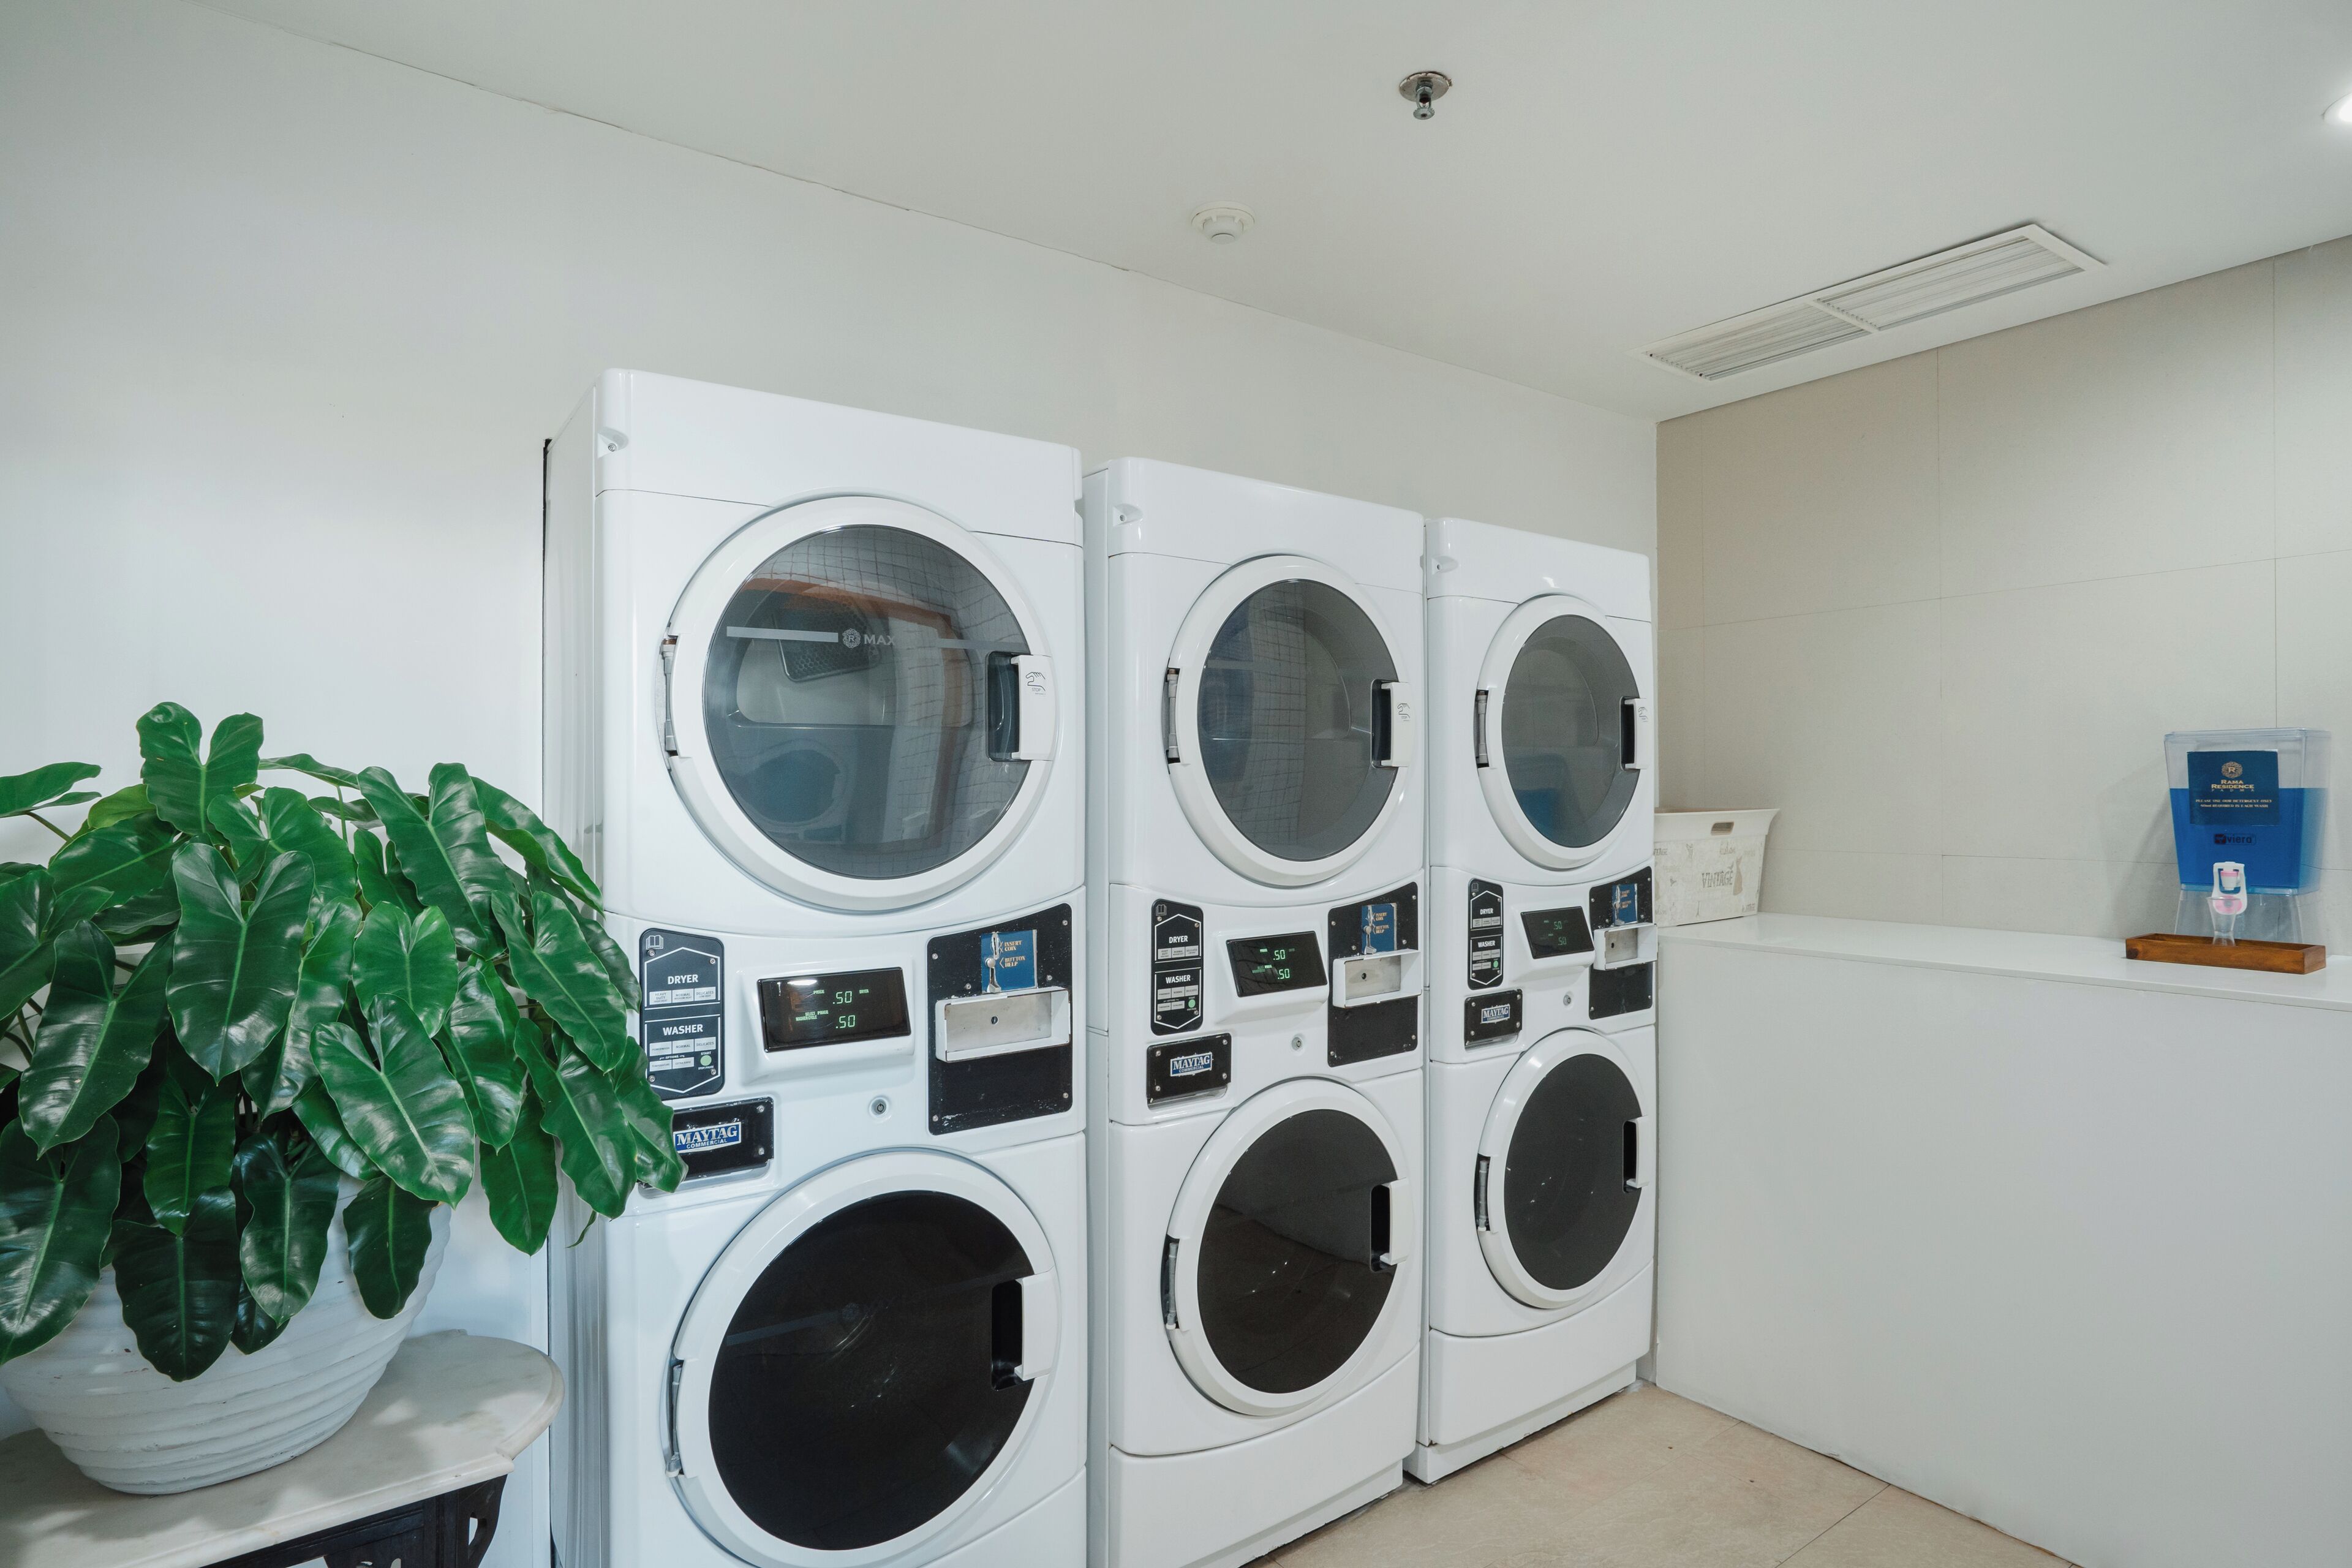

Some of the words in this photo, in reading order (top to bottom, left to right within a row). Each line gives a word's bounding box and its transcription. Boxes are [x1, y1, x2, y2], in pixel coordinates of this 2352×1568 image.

[1702, 870, 1733, 888] VINTAGE
[1169, 935, 1188, 944] DRYER
[1273, 949, 1285, 960] .50
[668, 974, 698, 984] DRYER
[1165, 974, 1191, 984] WASHER
[1278, 968, 1290, 979] .50
[832, 990, 853, 1005] .50
[1483, 1007, 1509, 1019] MAYTAG
[835, 1014, 856, 1028] .50
[663, 1024, 703, 1036] WASHER
[1173, 1055, 1210, 1070] MAYTAG
[677, 1126, 737, 1145] MAYTAG
[686, 1138, 728, 1149] COMMERCIAL
